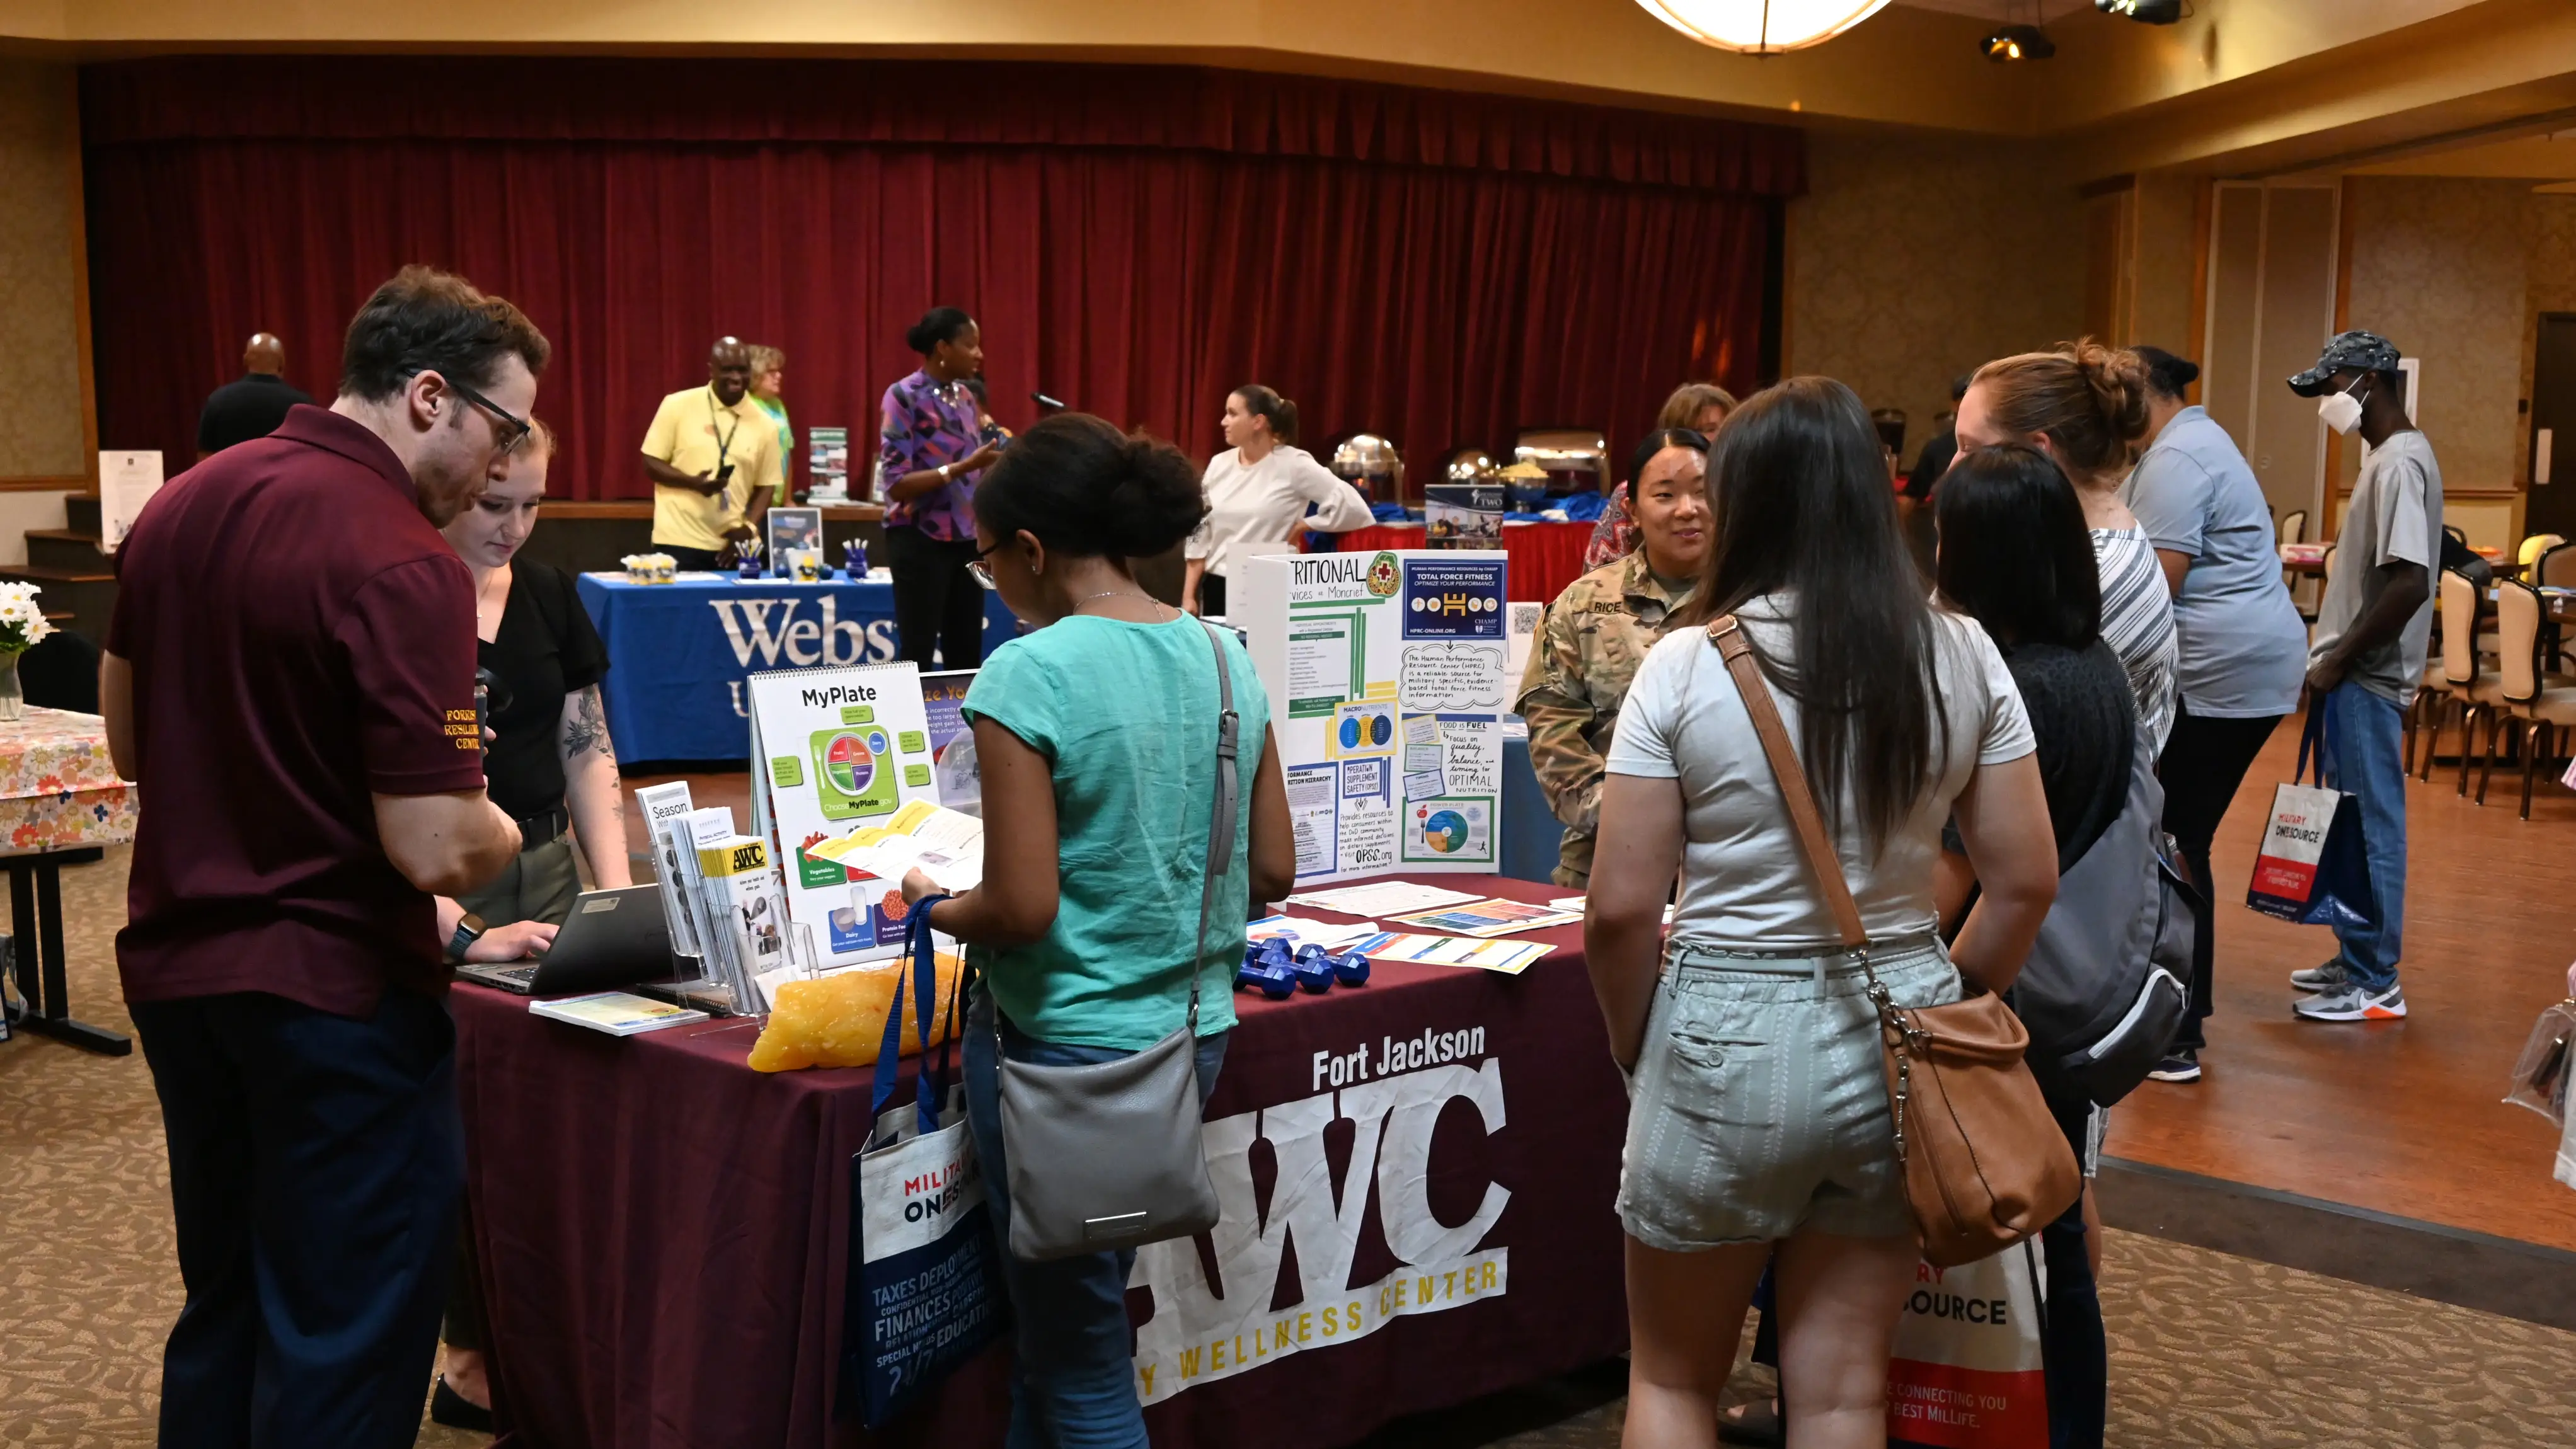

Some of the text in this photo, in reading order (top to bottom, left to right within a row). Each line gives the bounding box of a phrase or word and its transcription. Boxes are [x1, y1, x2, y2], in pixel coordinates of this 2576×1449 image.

[1289, 559, 1366, 585] RITIONAL
[1290, 588, 1313, 600] vices
[1328, 583, 1364, 598] Moncrief
[1594, 601, 1622, 613] RICE
[708, 593, 897, 667] Webs
[727, 681, 749, 717] U
[802, 685, 877, 708] MyPlate
[924, 685, 965, 702] ze Yo
[1343, 704, 1388, 713] MACRONUTRIENTS
[1451, 744, 1485, 757] quality,
[1448, 755, 1482, 765] balance,
[1305, 776, 1331, 784] HIERARCHY
[1347, 772, 1377, 784] SUPPLEMENT
[1449, 766, 1479, 778] timing
[1347, 782, 1378, 793] SAFETY (OPSS)
[1449, 775, 1492, 786] OPTIMAL
[653, 803, 688, 819] Season
[824, 798, 892, 811] ChooseMyPlate.gov
[1340, 812, 1360, 821] Provides
[2277, 813, 2307, 826] MILITARY
[1340, 821, 1349, 829] help
[1360, 828, 1384, 836] community
[2275, 825, 2321, 844] ONESOURCE
[733, 845, 764, 870] AWC
[1356, 849, 1392, 864] OPSS.org
[1313, 1025, 1485, 1092] Fort Jackson
[904, 1159, 981, 1222] ONESOUR
[872, 1278, 916, 1307] TAXES
[882, 1292, 929, 1317] CONFIDENTIAL
[1903, 1290, 2007, 1325] OURCE
[875, 1292, 950, 1341] FINANCES
[1178, 1301, 1363, 1381] WELLNESS
[1379, 1260, 1497, 1317] CENTER
[877, 1347, 911, 1368] SPECIAL
[937, 1300, 989, 1347] EDUCATI
[1897, 1383, 1974, 1407] CONNECTING
[1979, 1395, 2006, 1411] YOU
[1894, 1402, 1923, 1418] BEST
